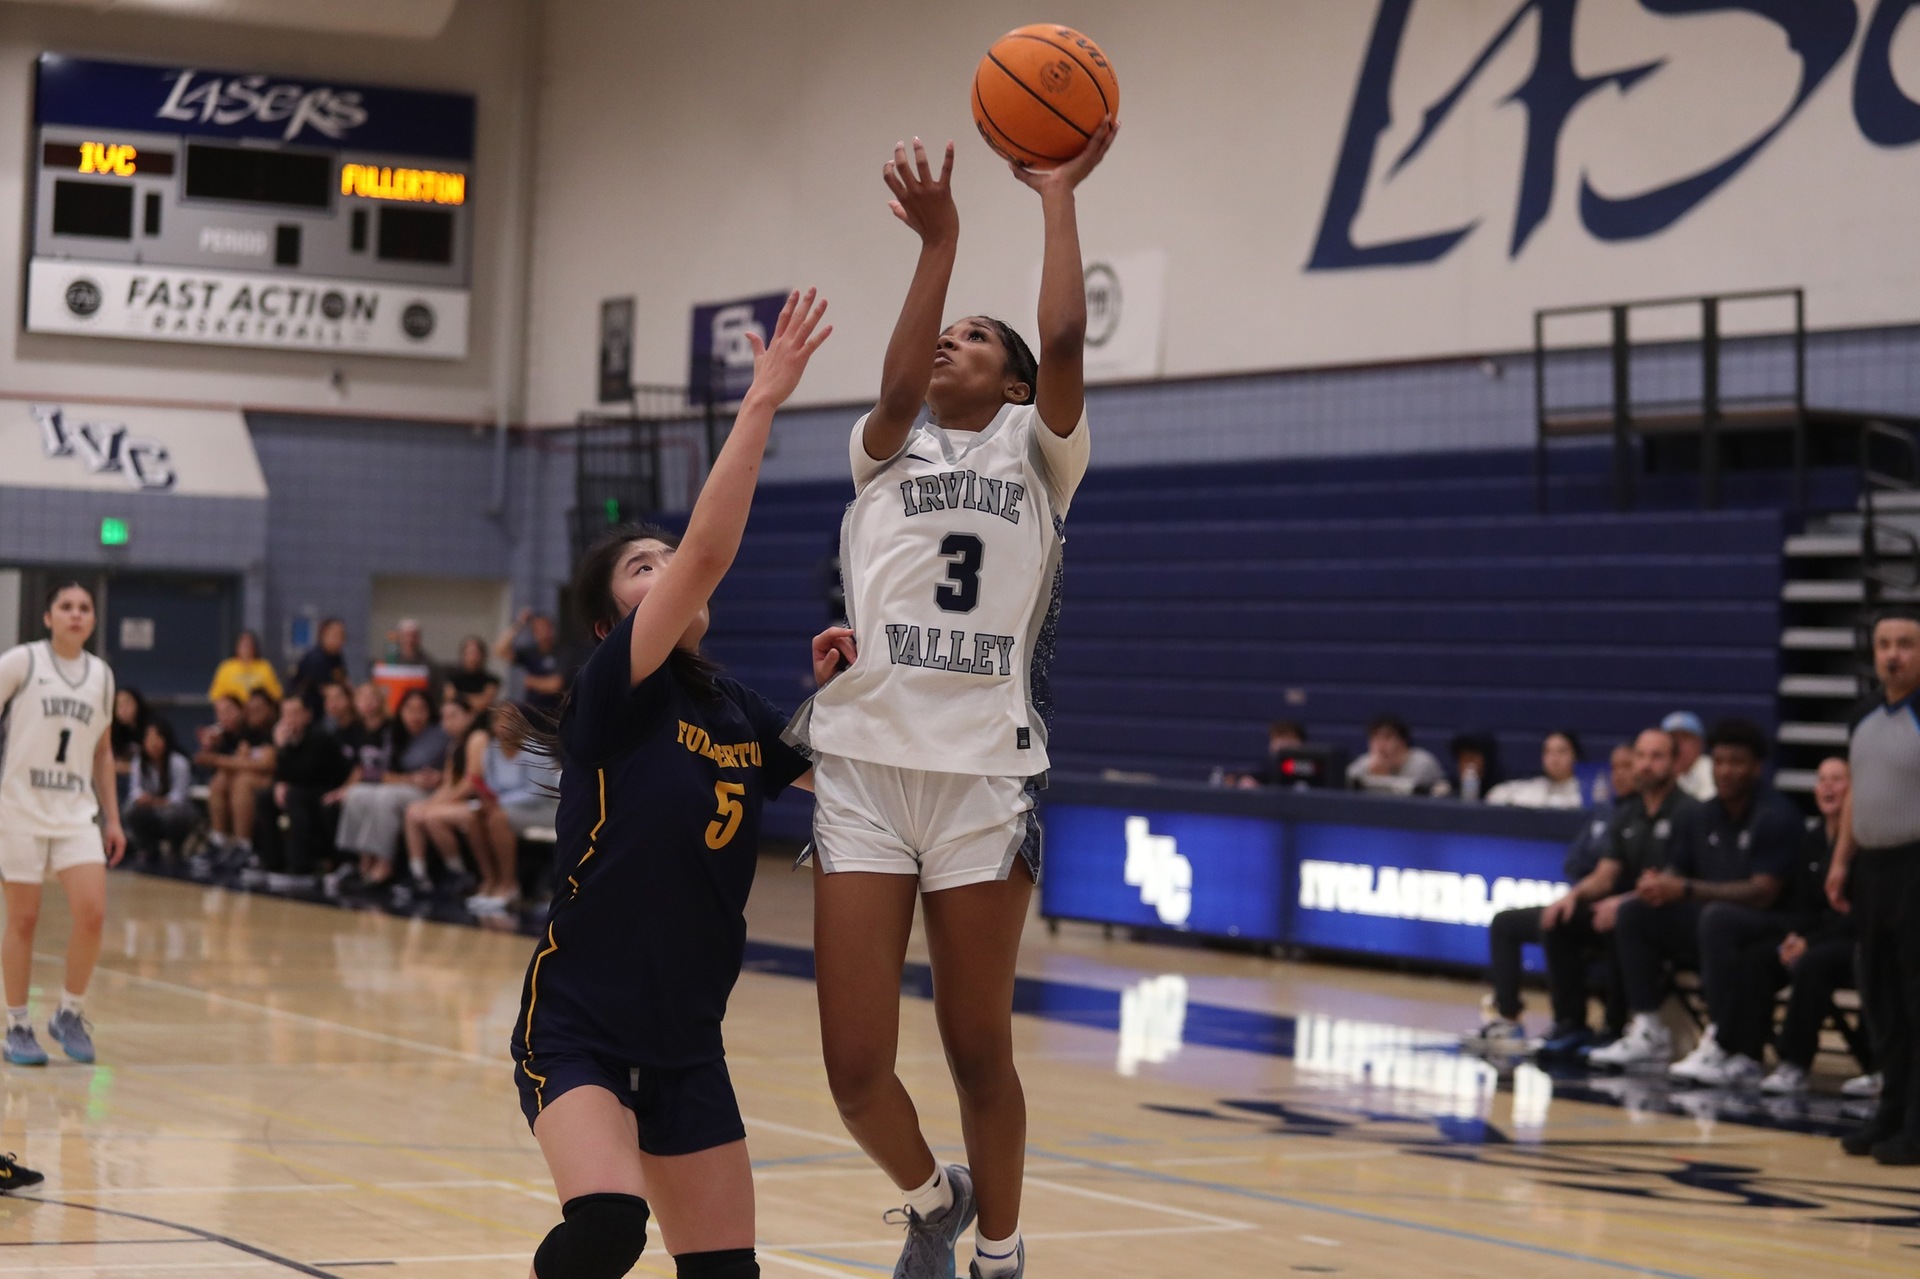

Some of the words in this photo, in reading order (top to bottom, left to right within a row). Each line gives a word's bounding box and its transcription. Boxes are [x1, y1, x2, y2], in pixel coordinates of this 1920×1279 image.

[78, 141, 137, 177] IVC
[341, 163, 466, 205] FULLERTON
[199, 227, 268, 256] PERIOD
[126, 276, 219, 311] FAST
[228, 285, 381, 323] ACTION
[152, 314, 346, 343] BASKETBALL
[32, 403, 177, 492] IVC
[900, 469, 1024, 525] IRVINE
[934, 531, 986, 615] 3
[885, 623, 1015, 676] VALLEY
[55, 729, 71, 765] 1
[29, 767, 86, 793] VALLEY
[704, 780, 746, 850] 5
